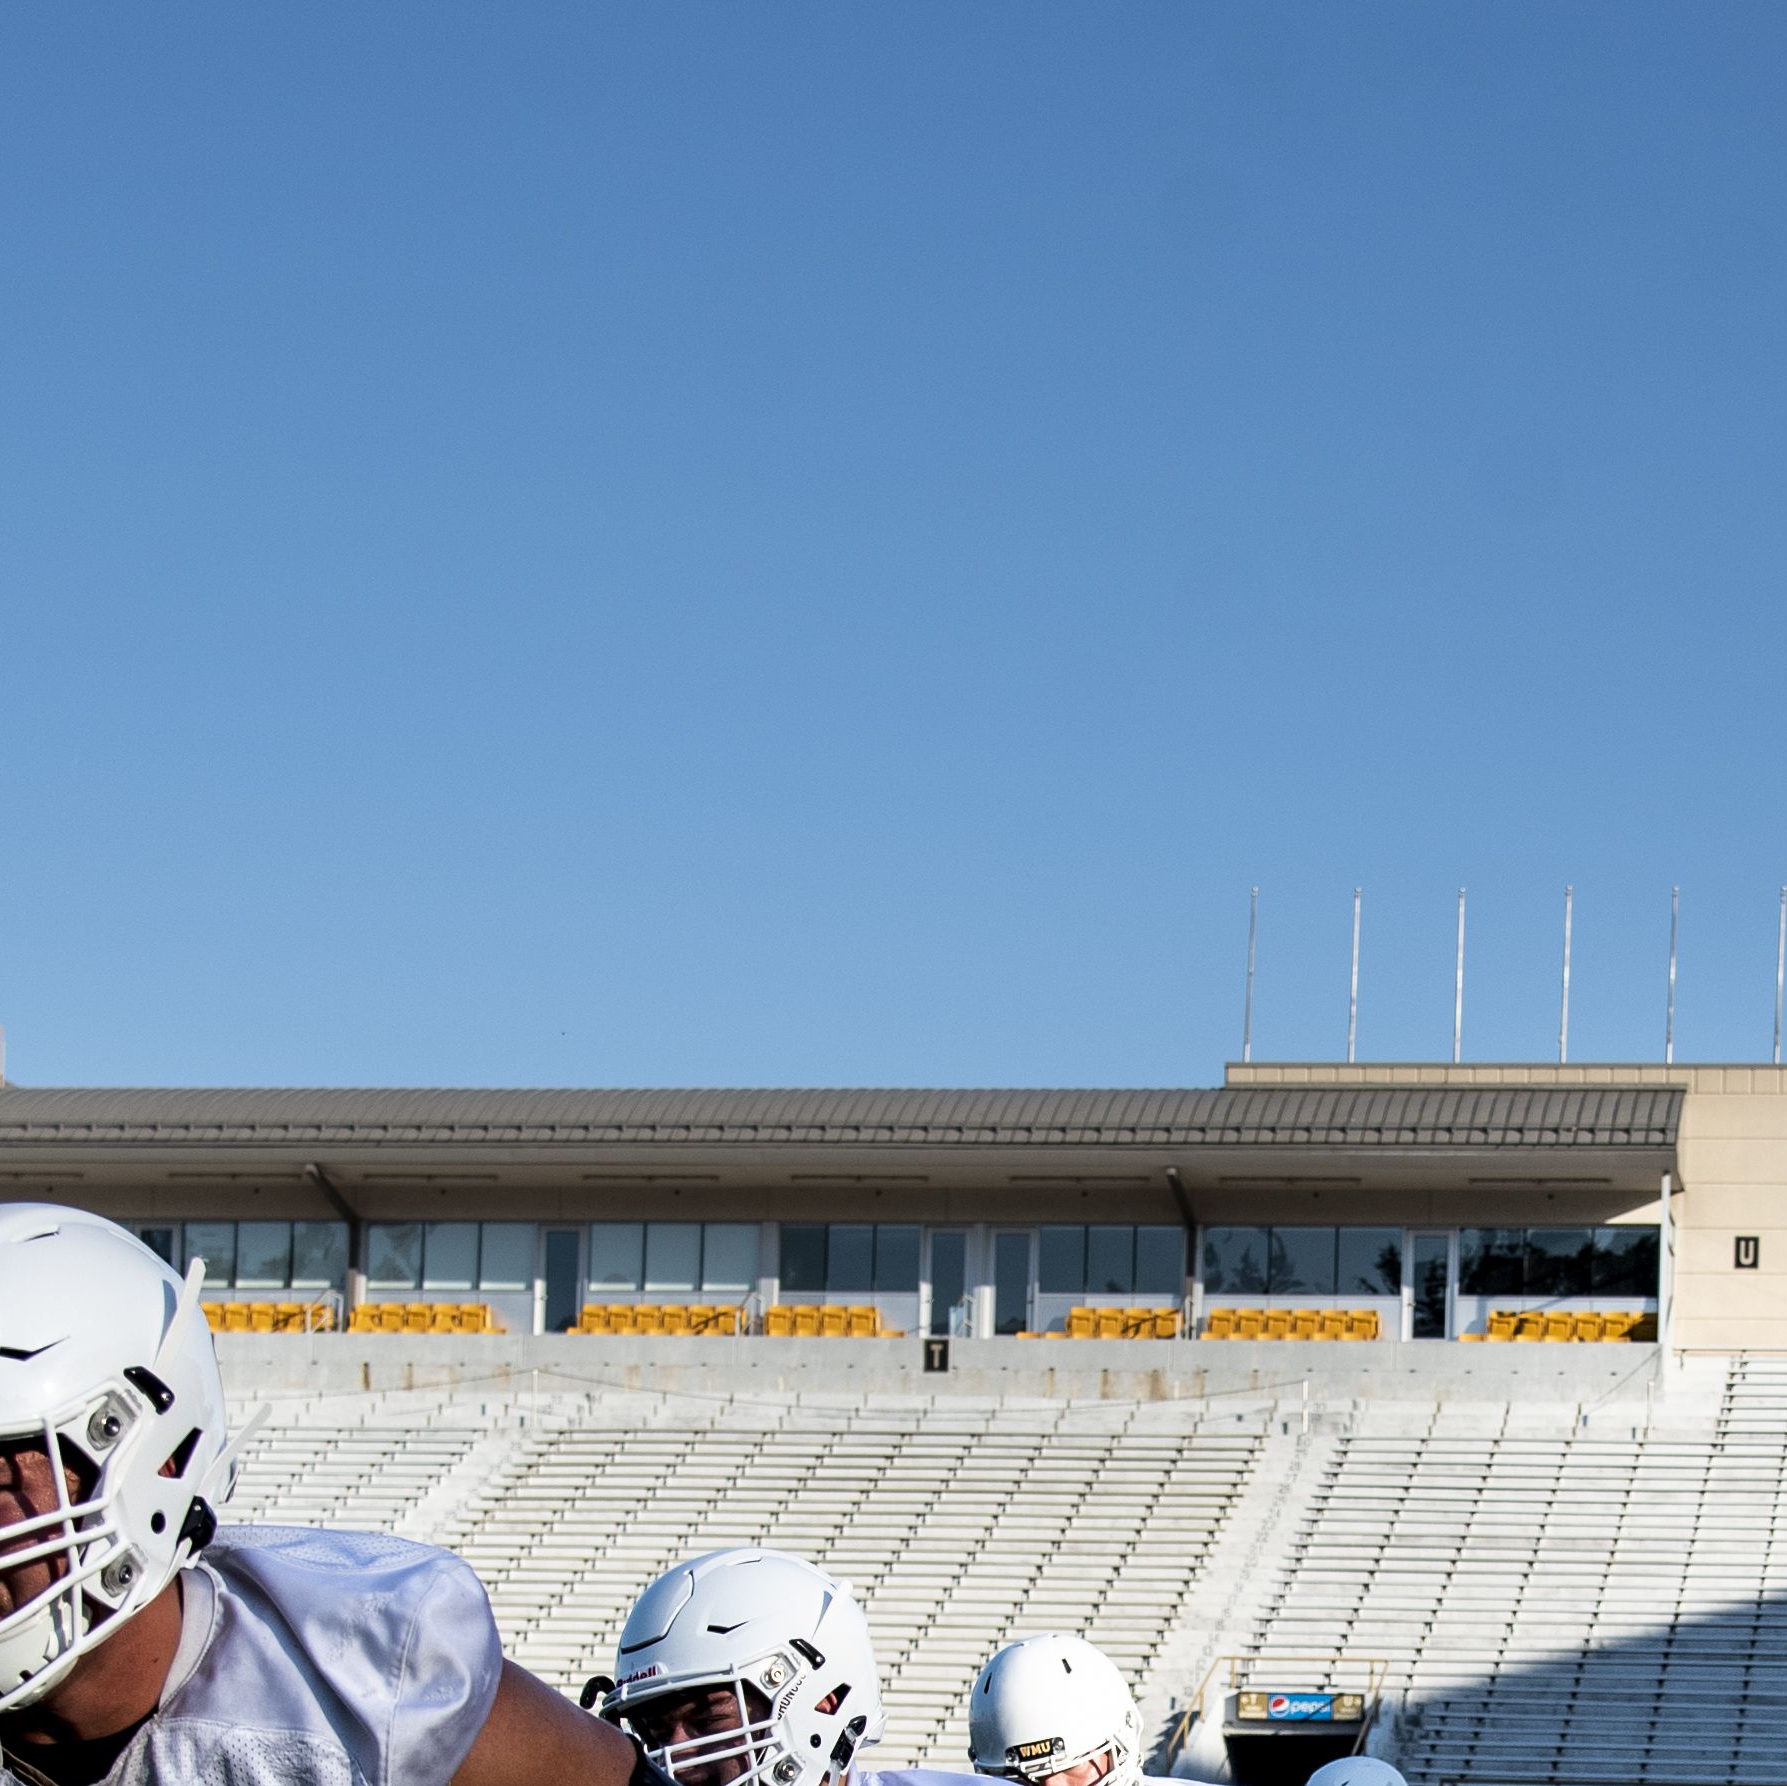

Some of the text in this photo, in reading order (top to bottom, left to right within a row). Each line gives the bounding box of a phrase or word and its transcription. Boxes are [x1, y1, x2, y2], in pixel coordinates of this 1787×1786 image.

[1739, 1240, 1755, 1266] U
[929, 1343, 944, 1369] T
[1018, 1741, 1052, 1758] WMU
